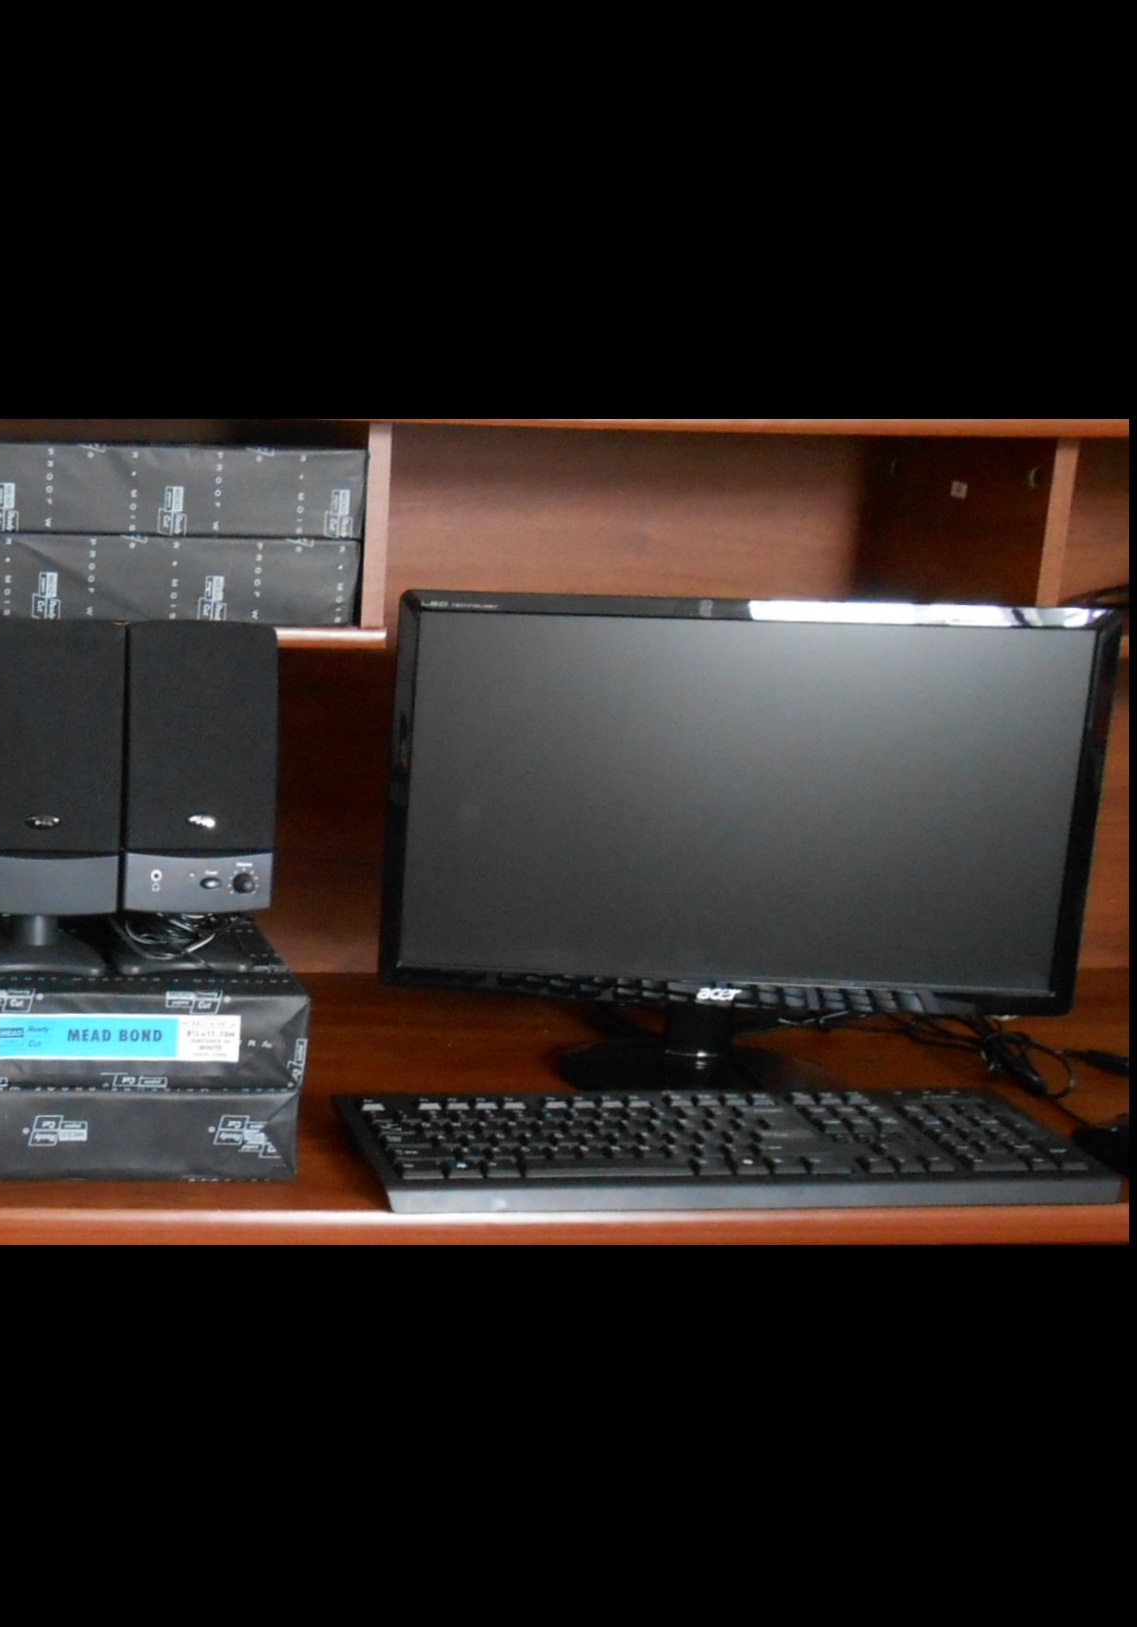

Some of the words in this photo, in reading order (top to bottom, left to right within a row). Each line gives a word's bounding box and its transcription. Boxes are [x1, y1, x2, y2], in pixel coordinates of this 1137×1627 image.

[696, 987, 742, 1001] acer
[67, 1029, 112, 1042] MEAD
[119, 1029, 163, 1042] BOND
[42, 1120, 56, 1129] Cut
